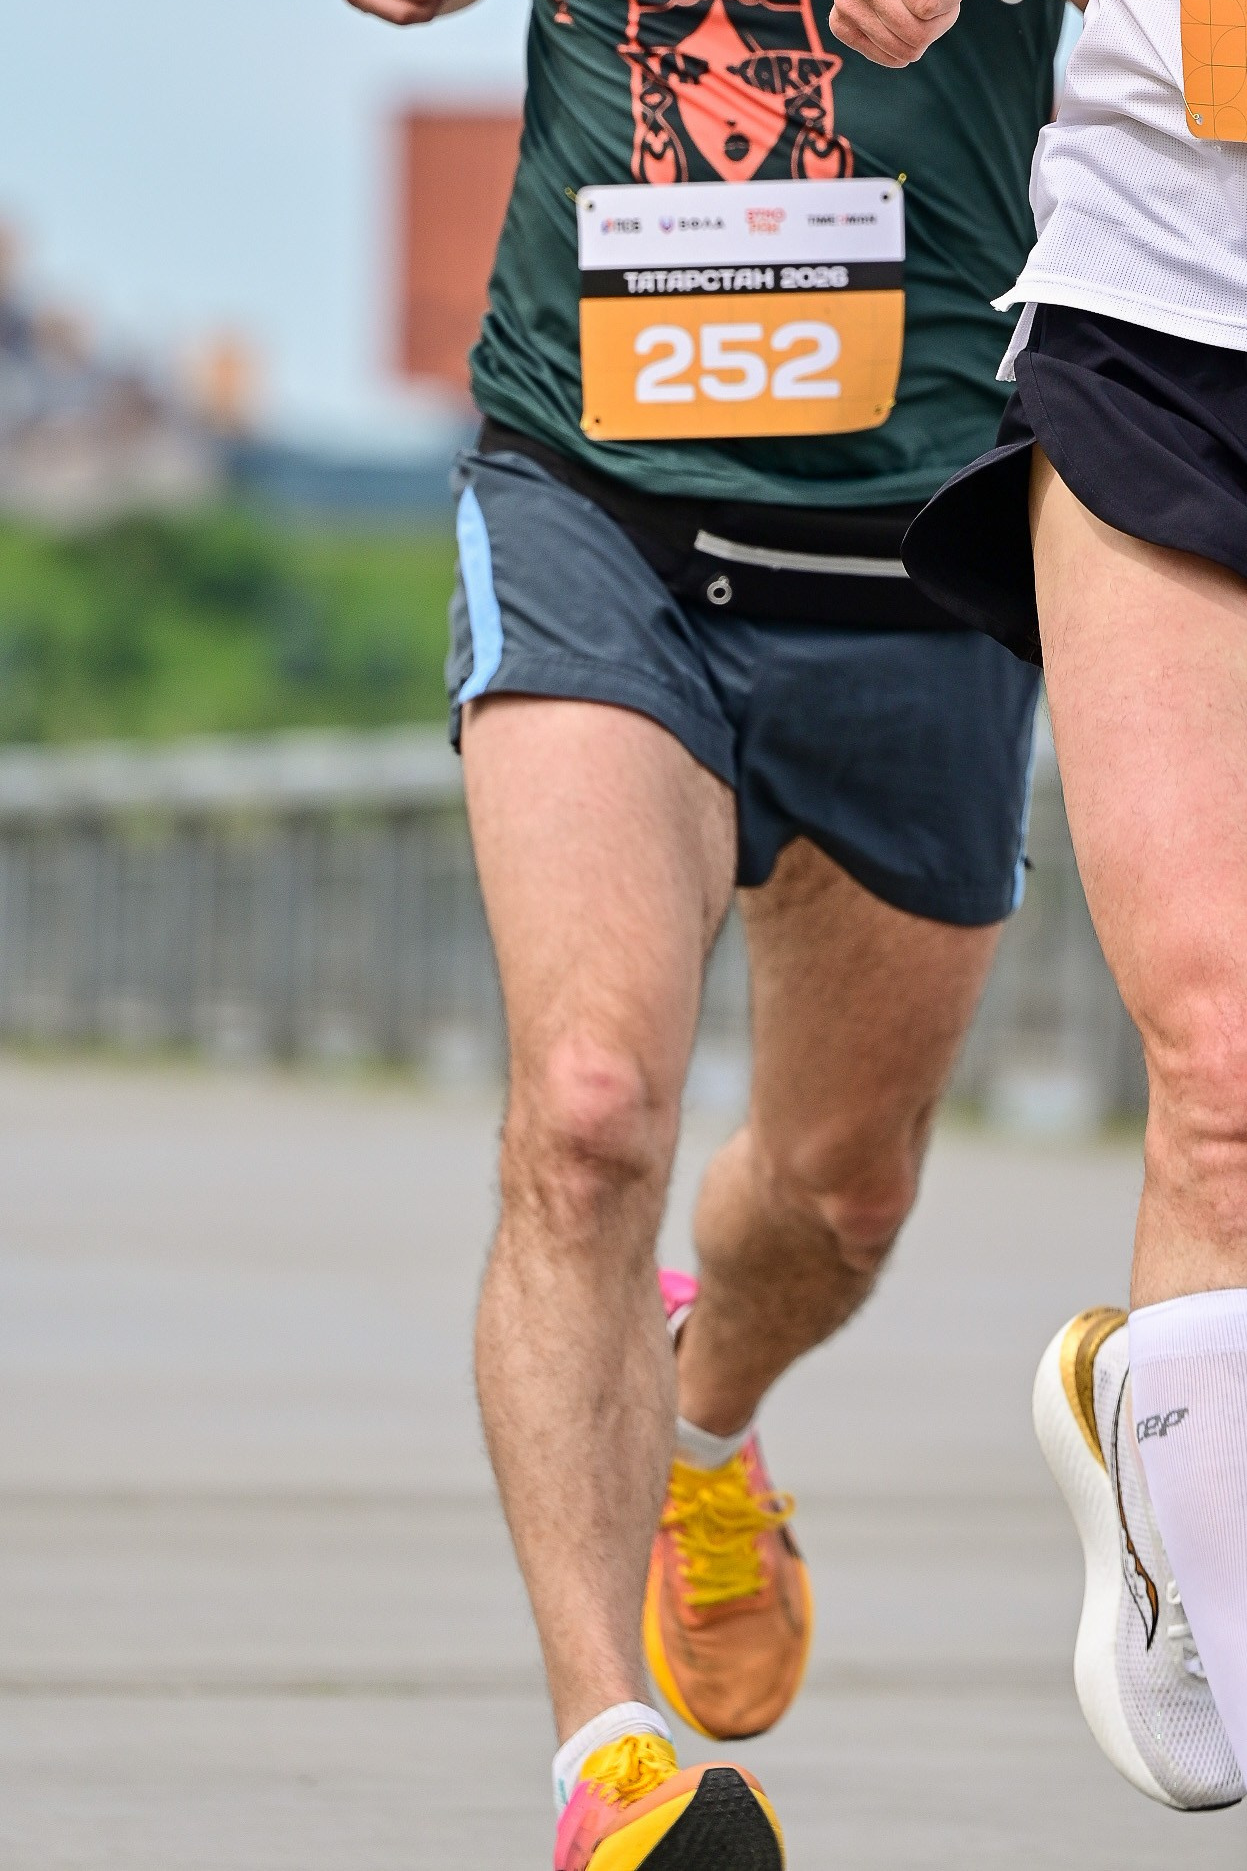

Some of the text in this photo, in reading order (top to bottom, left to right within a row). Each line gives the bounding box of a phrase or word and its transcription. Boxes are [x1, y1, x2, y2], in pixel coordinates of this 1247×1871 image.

[624, 266, 849, 293] ТАТАРСТАН 2026
[634, 320, 841, 404] 252
